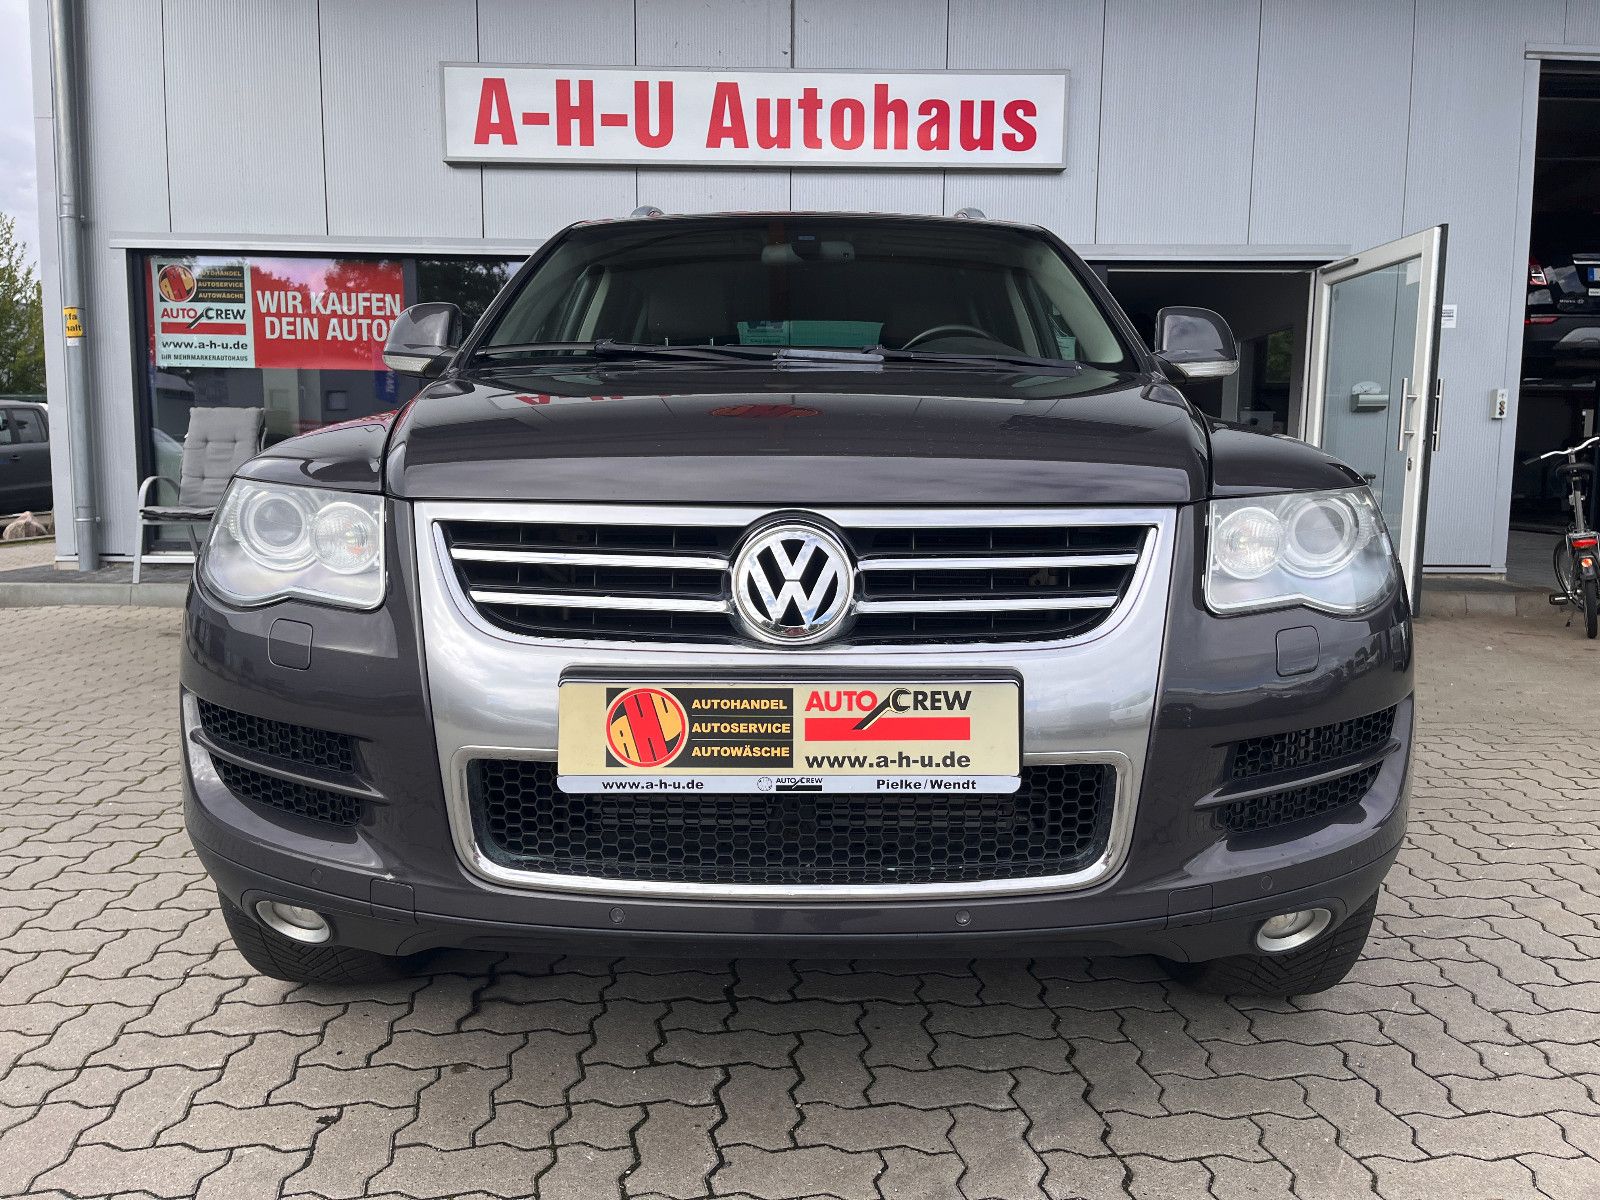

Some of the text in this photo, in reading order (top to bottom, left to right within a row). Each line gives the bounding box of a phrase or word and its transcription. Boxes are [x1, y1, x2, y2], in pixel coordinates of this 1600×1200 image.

[474, 77, 1037, 151] A-H-U Autohaus
[256, 290, 401, 316] WIR KAUFEN
[161, 307, 246, 320] AUTO CREW
[264, 317, 319, 340] DEIN
[161, 340, 248, 350] www.a-h-u.de
[173, 354, 248, 362] MEHRMARKENAUTOHAUS
[692, 699, 788, 710] AUTOHANDEL
[805, 688, 972, 713] AUTO CREW
[692, 723, 791, 734] AUTOSERVICE
[692, 745, 790, 757] AUTOWÄSCHE
[805, 751, 971, 769] www.a-h-u.de
[602, 779, 704, 790] www.a-h-u.de
[800, 776, 823, 784] CREW
